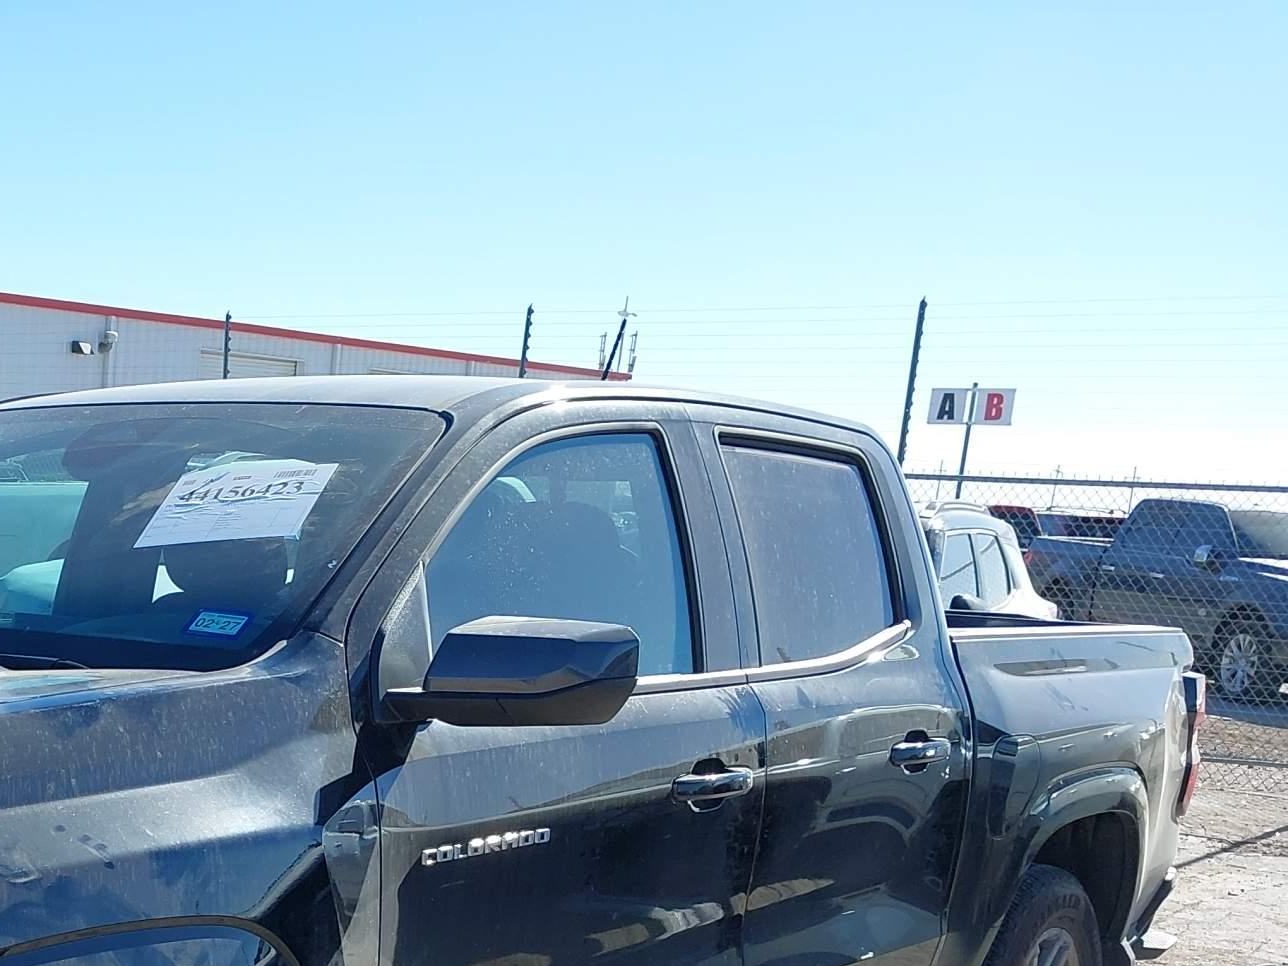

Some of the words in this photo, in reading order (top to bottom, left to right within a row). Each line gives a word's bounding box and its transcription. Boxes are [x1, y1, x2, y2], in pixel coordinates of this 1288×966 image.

[936, 392, 955, 420] A
[983, 392, 1004, 420] B
[179, 481, 305, 502] 44156423
[195, 618, 216, 628] 02
[219, 620, 241, 631] 27
[421, 827, 551, 866] COLORADO
